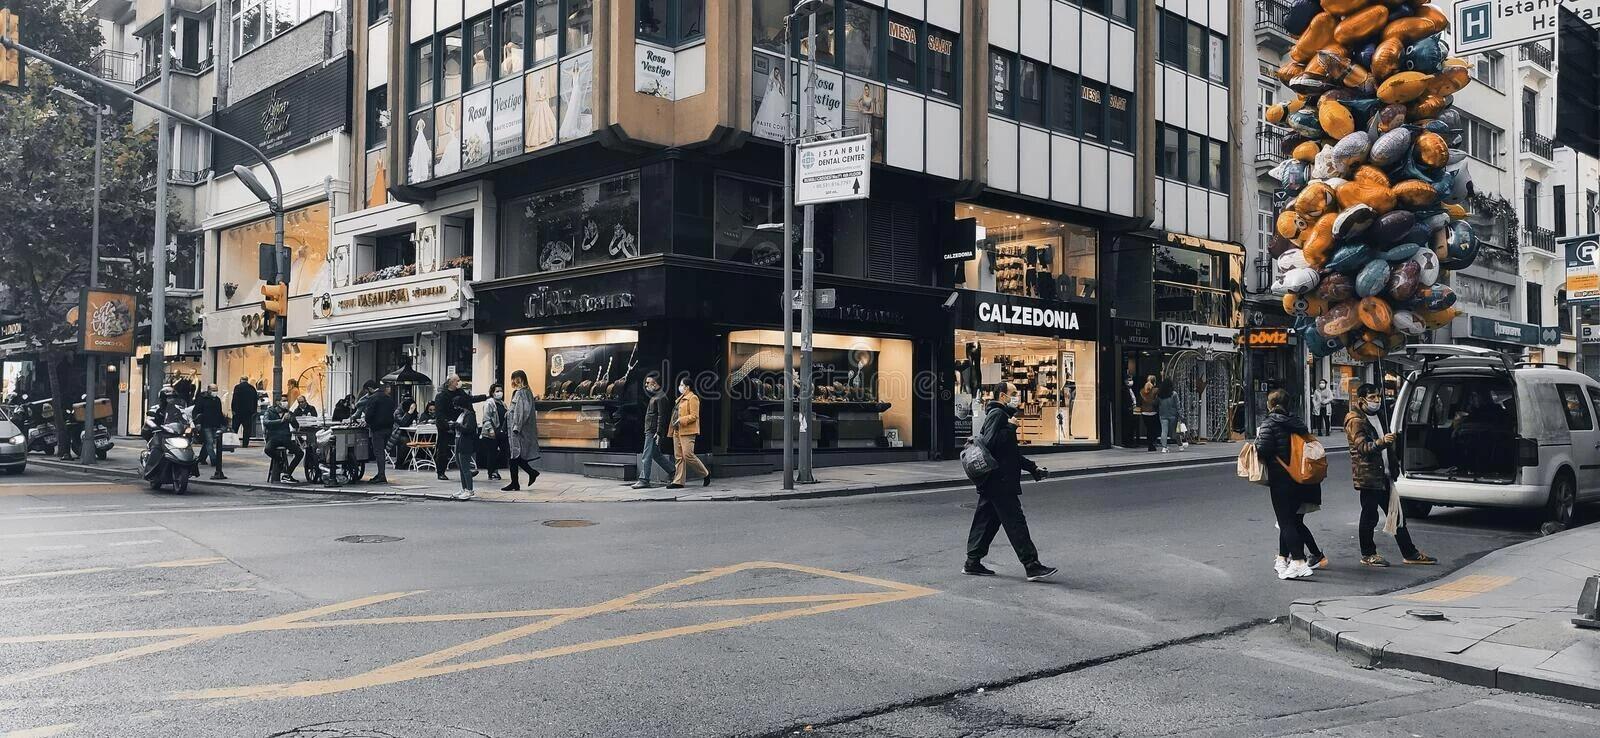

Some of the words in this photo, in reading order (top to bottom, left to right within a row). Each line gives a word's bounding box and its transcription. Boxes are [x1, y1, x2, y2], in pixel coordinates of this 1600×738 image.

[889, 21, 917, 45] MESA
[928, 35, 952, 55] SAAT
[646, 50, 666, 64] Rosa
[641, 61, 671, 78] Vestigo
[468, 105, 487, 122] Rosa
[494, 94, 522, 112] Vestigo
[818, 158, 840, 167] DENTAL
[842, 153, 865, 163] CENTER
[943, 251, 973, 260] CALZEDONIA
[978, 302, 1080, 330] CALZEDONIA
[1165, 324, 1193, 347] DIA
